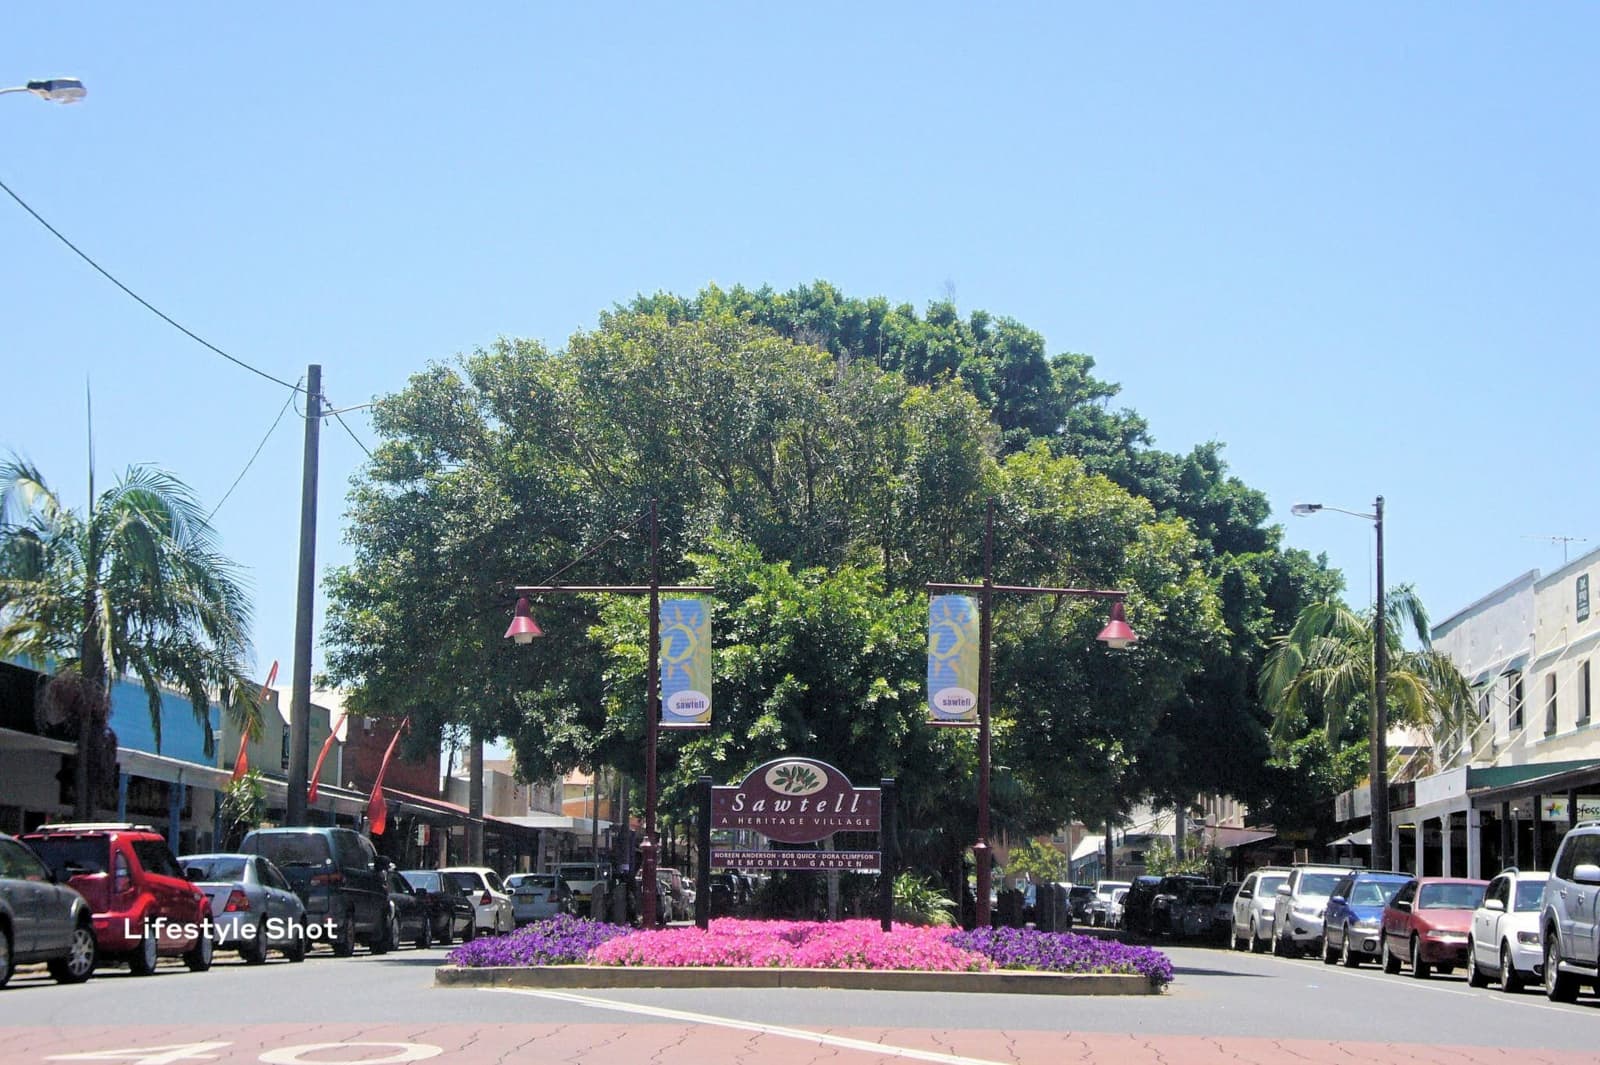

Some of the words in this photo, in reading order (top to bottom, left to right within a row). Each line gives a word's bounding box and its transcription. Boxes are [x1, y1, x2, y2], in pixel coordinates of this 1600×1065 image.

[676, 700, 704, 709] sawtell
[732, 793, 860, 813] Sawtell
[738, 817, 804, 825] HERITAGE
[814, 818, 871, 826] VILLAGE
